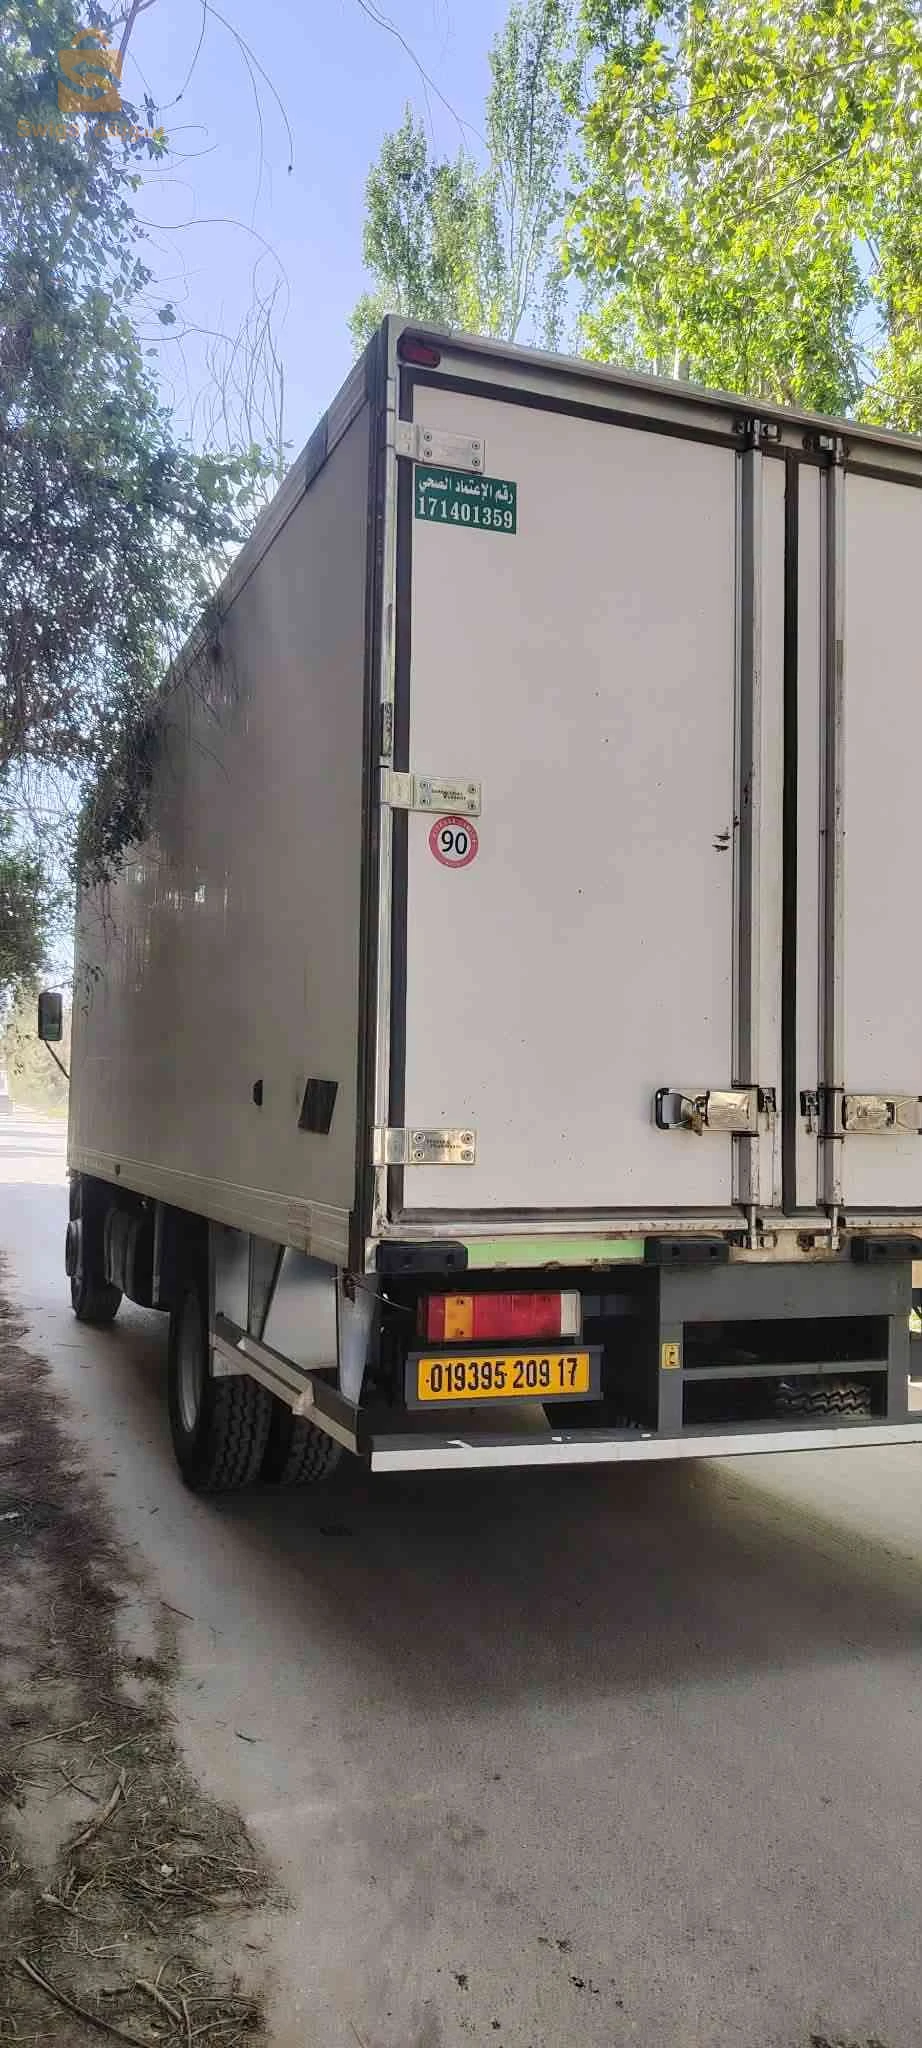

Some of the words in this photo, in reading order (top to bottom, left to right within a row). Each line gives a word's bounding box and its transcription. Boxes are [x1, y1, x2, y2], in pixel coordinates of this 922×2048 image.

[418, 477, 453, 493] الصحي
[495, 484, 513, 504] رقم
[418, 496, 513, 529] 171401359
[441, 830, 468, 855] 90
[430, 1361, 506, 1392] 019395
[513, 1359, 550, 1389] 209
[558, 1358, 578, 1386] 17
